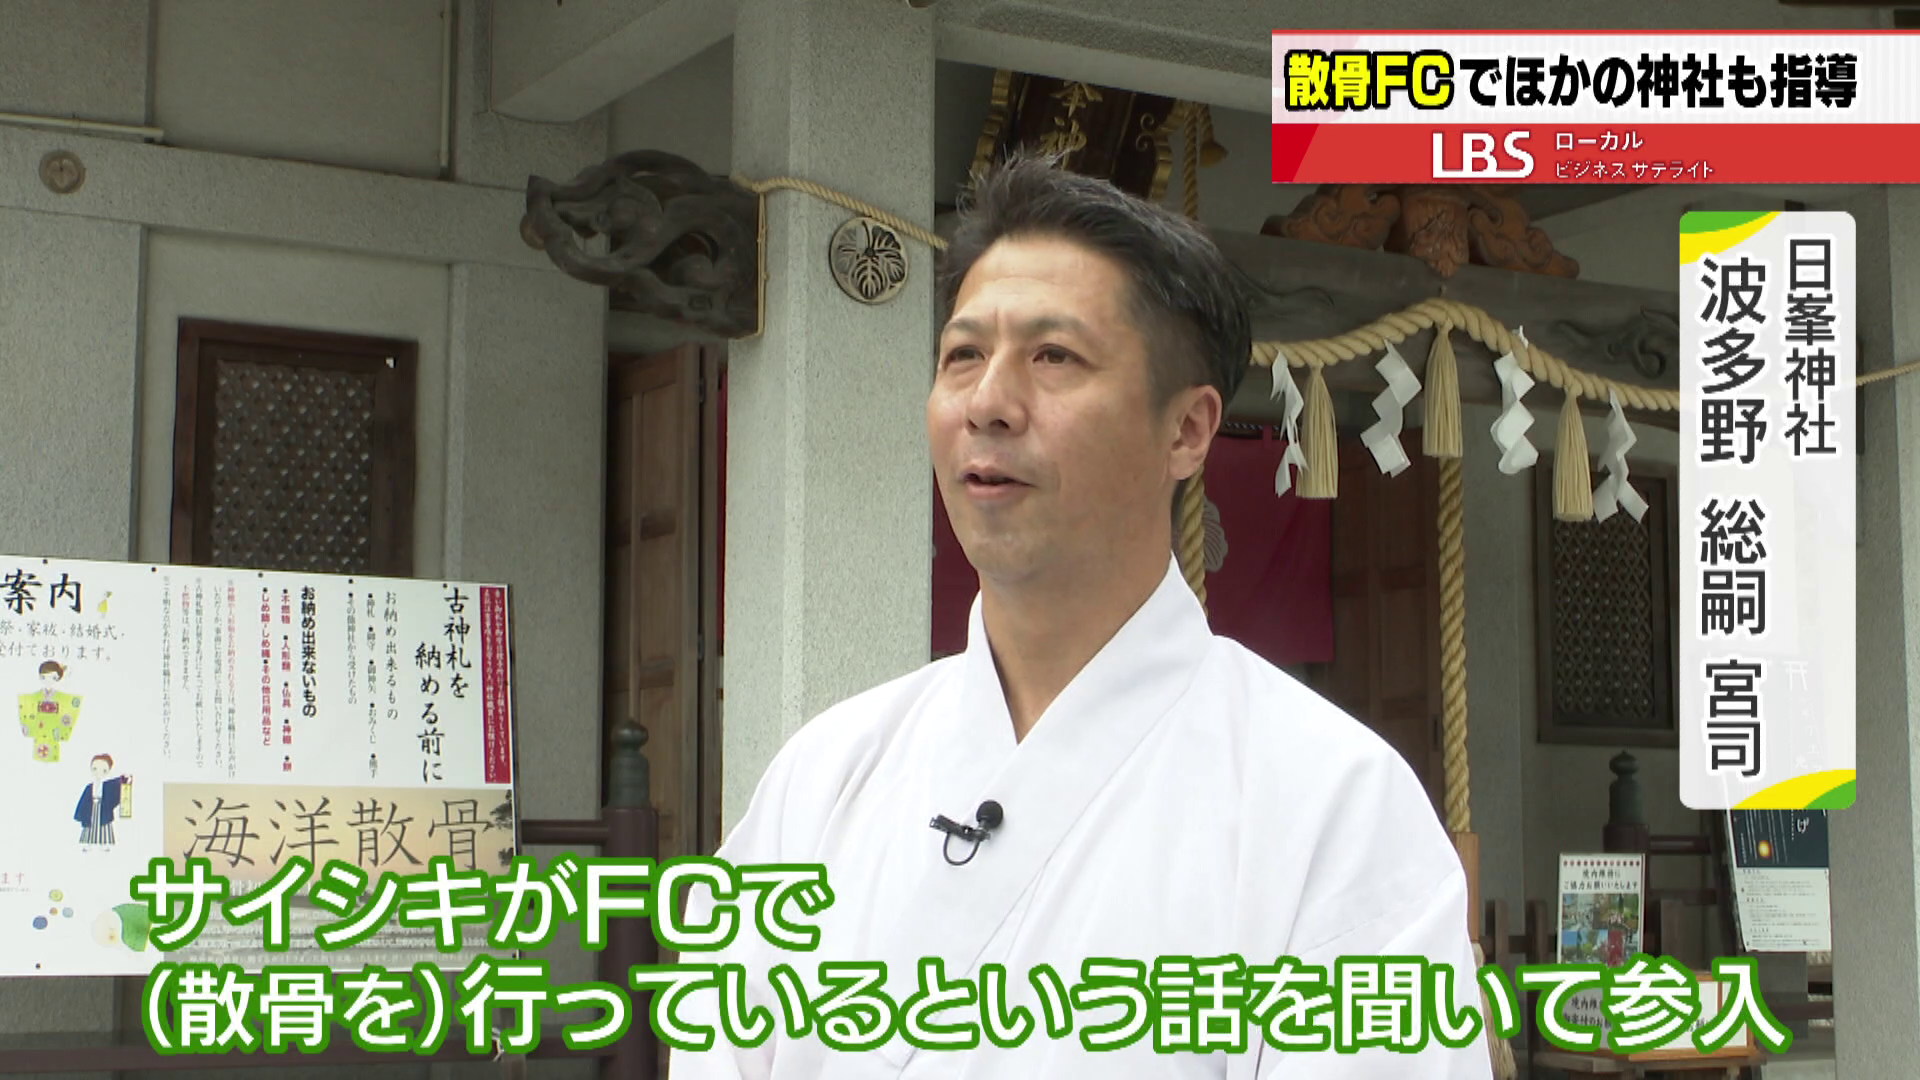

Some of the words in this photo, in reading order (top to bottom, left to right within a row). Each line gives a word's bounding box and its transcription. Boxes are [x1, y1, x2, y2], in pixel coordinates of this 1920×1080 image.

[0, 568, 83, 615] 案内
[300, 586, 317, 718] お納め出来ないもの
[443, 587, 472, 699] 古神札を
[384, 591, 398, 721] お納め出来るもの
[414, 642, 445, 783] 納める前に
[182, 795, 495, 871] 海洋散骨
